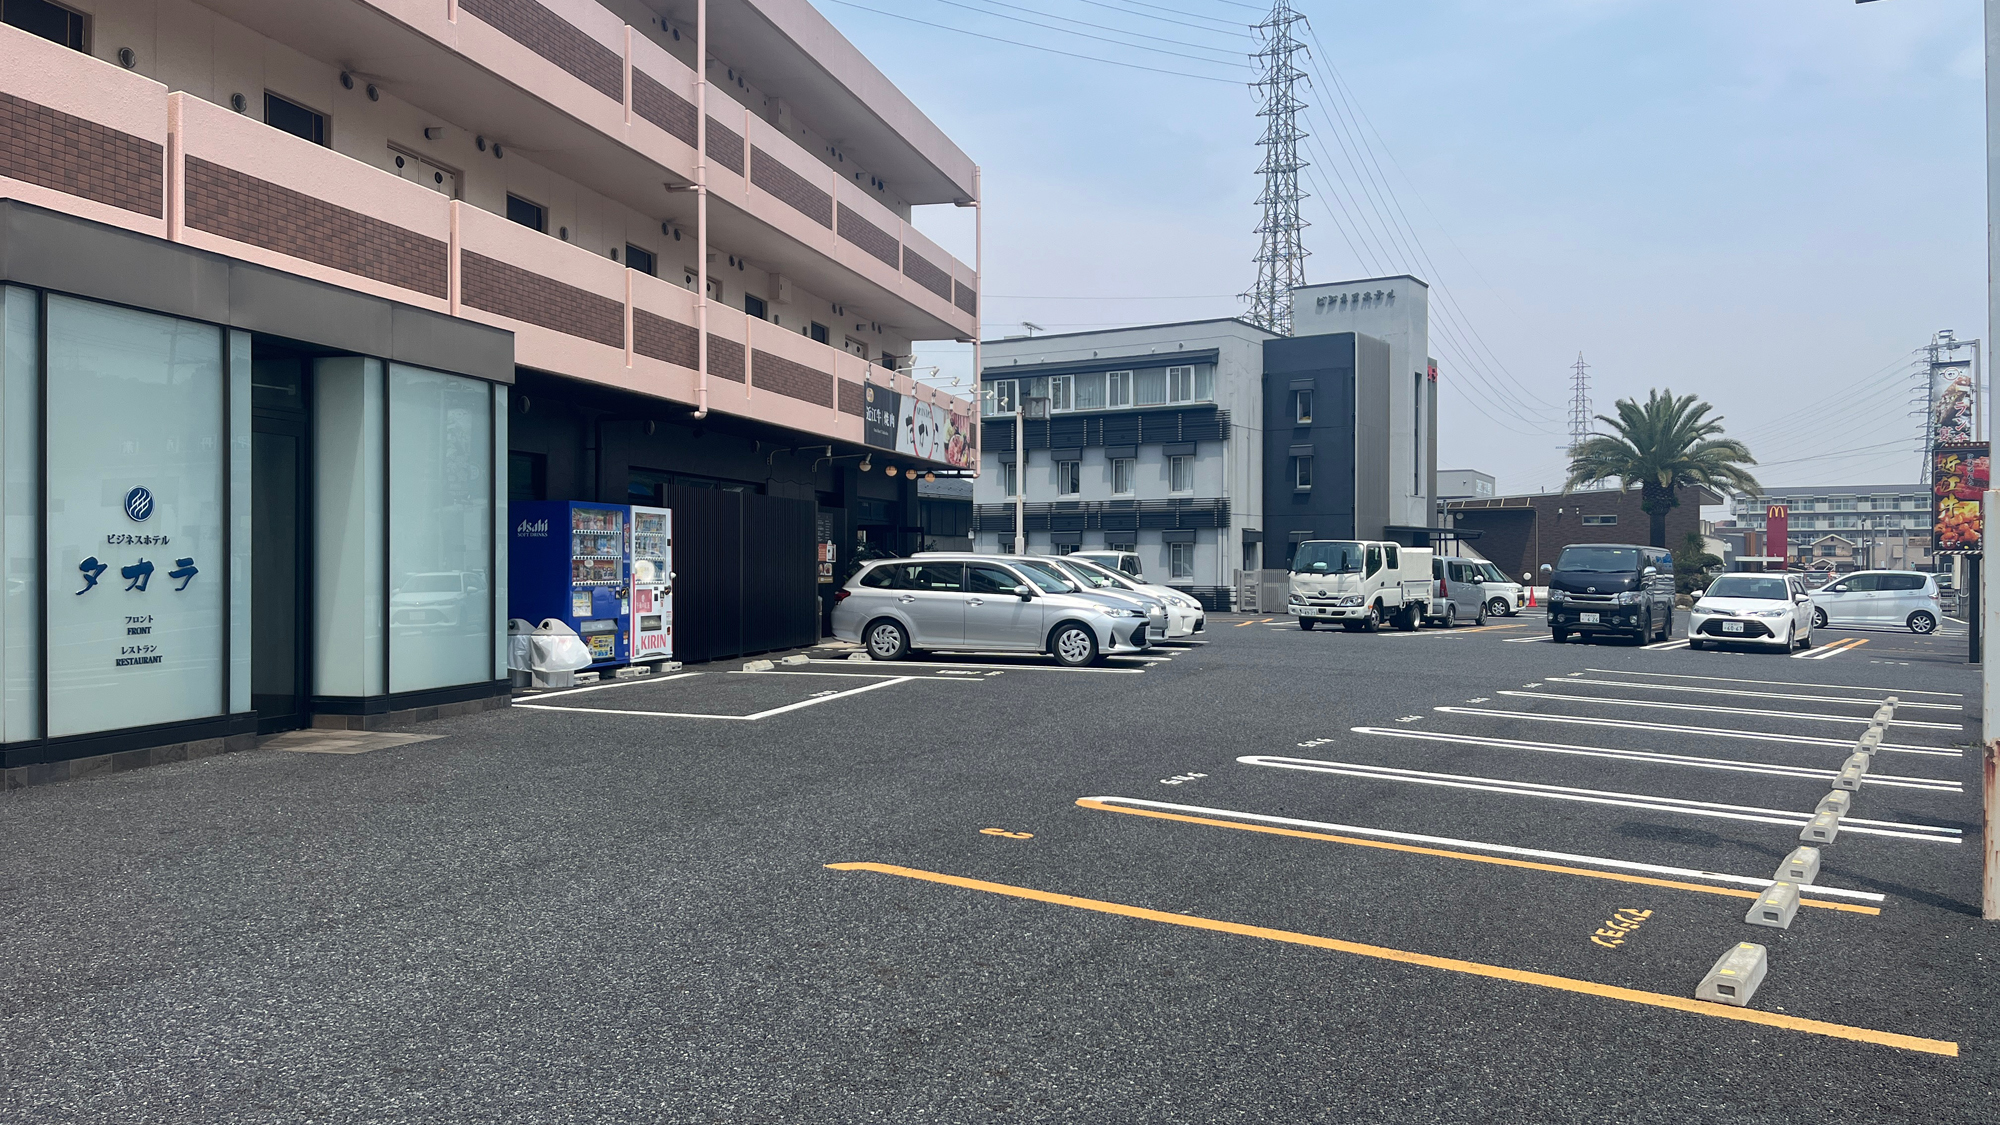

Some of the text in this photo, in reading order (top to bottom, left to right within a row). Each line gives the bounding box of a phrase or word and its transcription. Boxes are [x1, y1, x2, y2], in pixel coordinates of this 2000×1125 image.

[1317, 289, 1396, 306] ビジネスホテル
[866, 406, 882, 424] 近江牛
[1954, 402, 1968, 443] ランチ
[1938, 453, 1964, 518] 近江牛
[517, 519, 548, 532] Asahi
[107, 534, 170, 545] ビジネスホテル
[75, 556, 199, 595] タカラ
[125, 615, 153, 624] フロント
[127, 627, 152, 635] FRONT
[121, 645, 157, 654] レストラン
[641, 634, 666, 650] KIRIN
[115, 656, 163, 667] RESTAURANT
[1590, 908, 1654, 948] マンション
